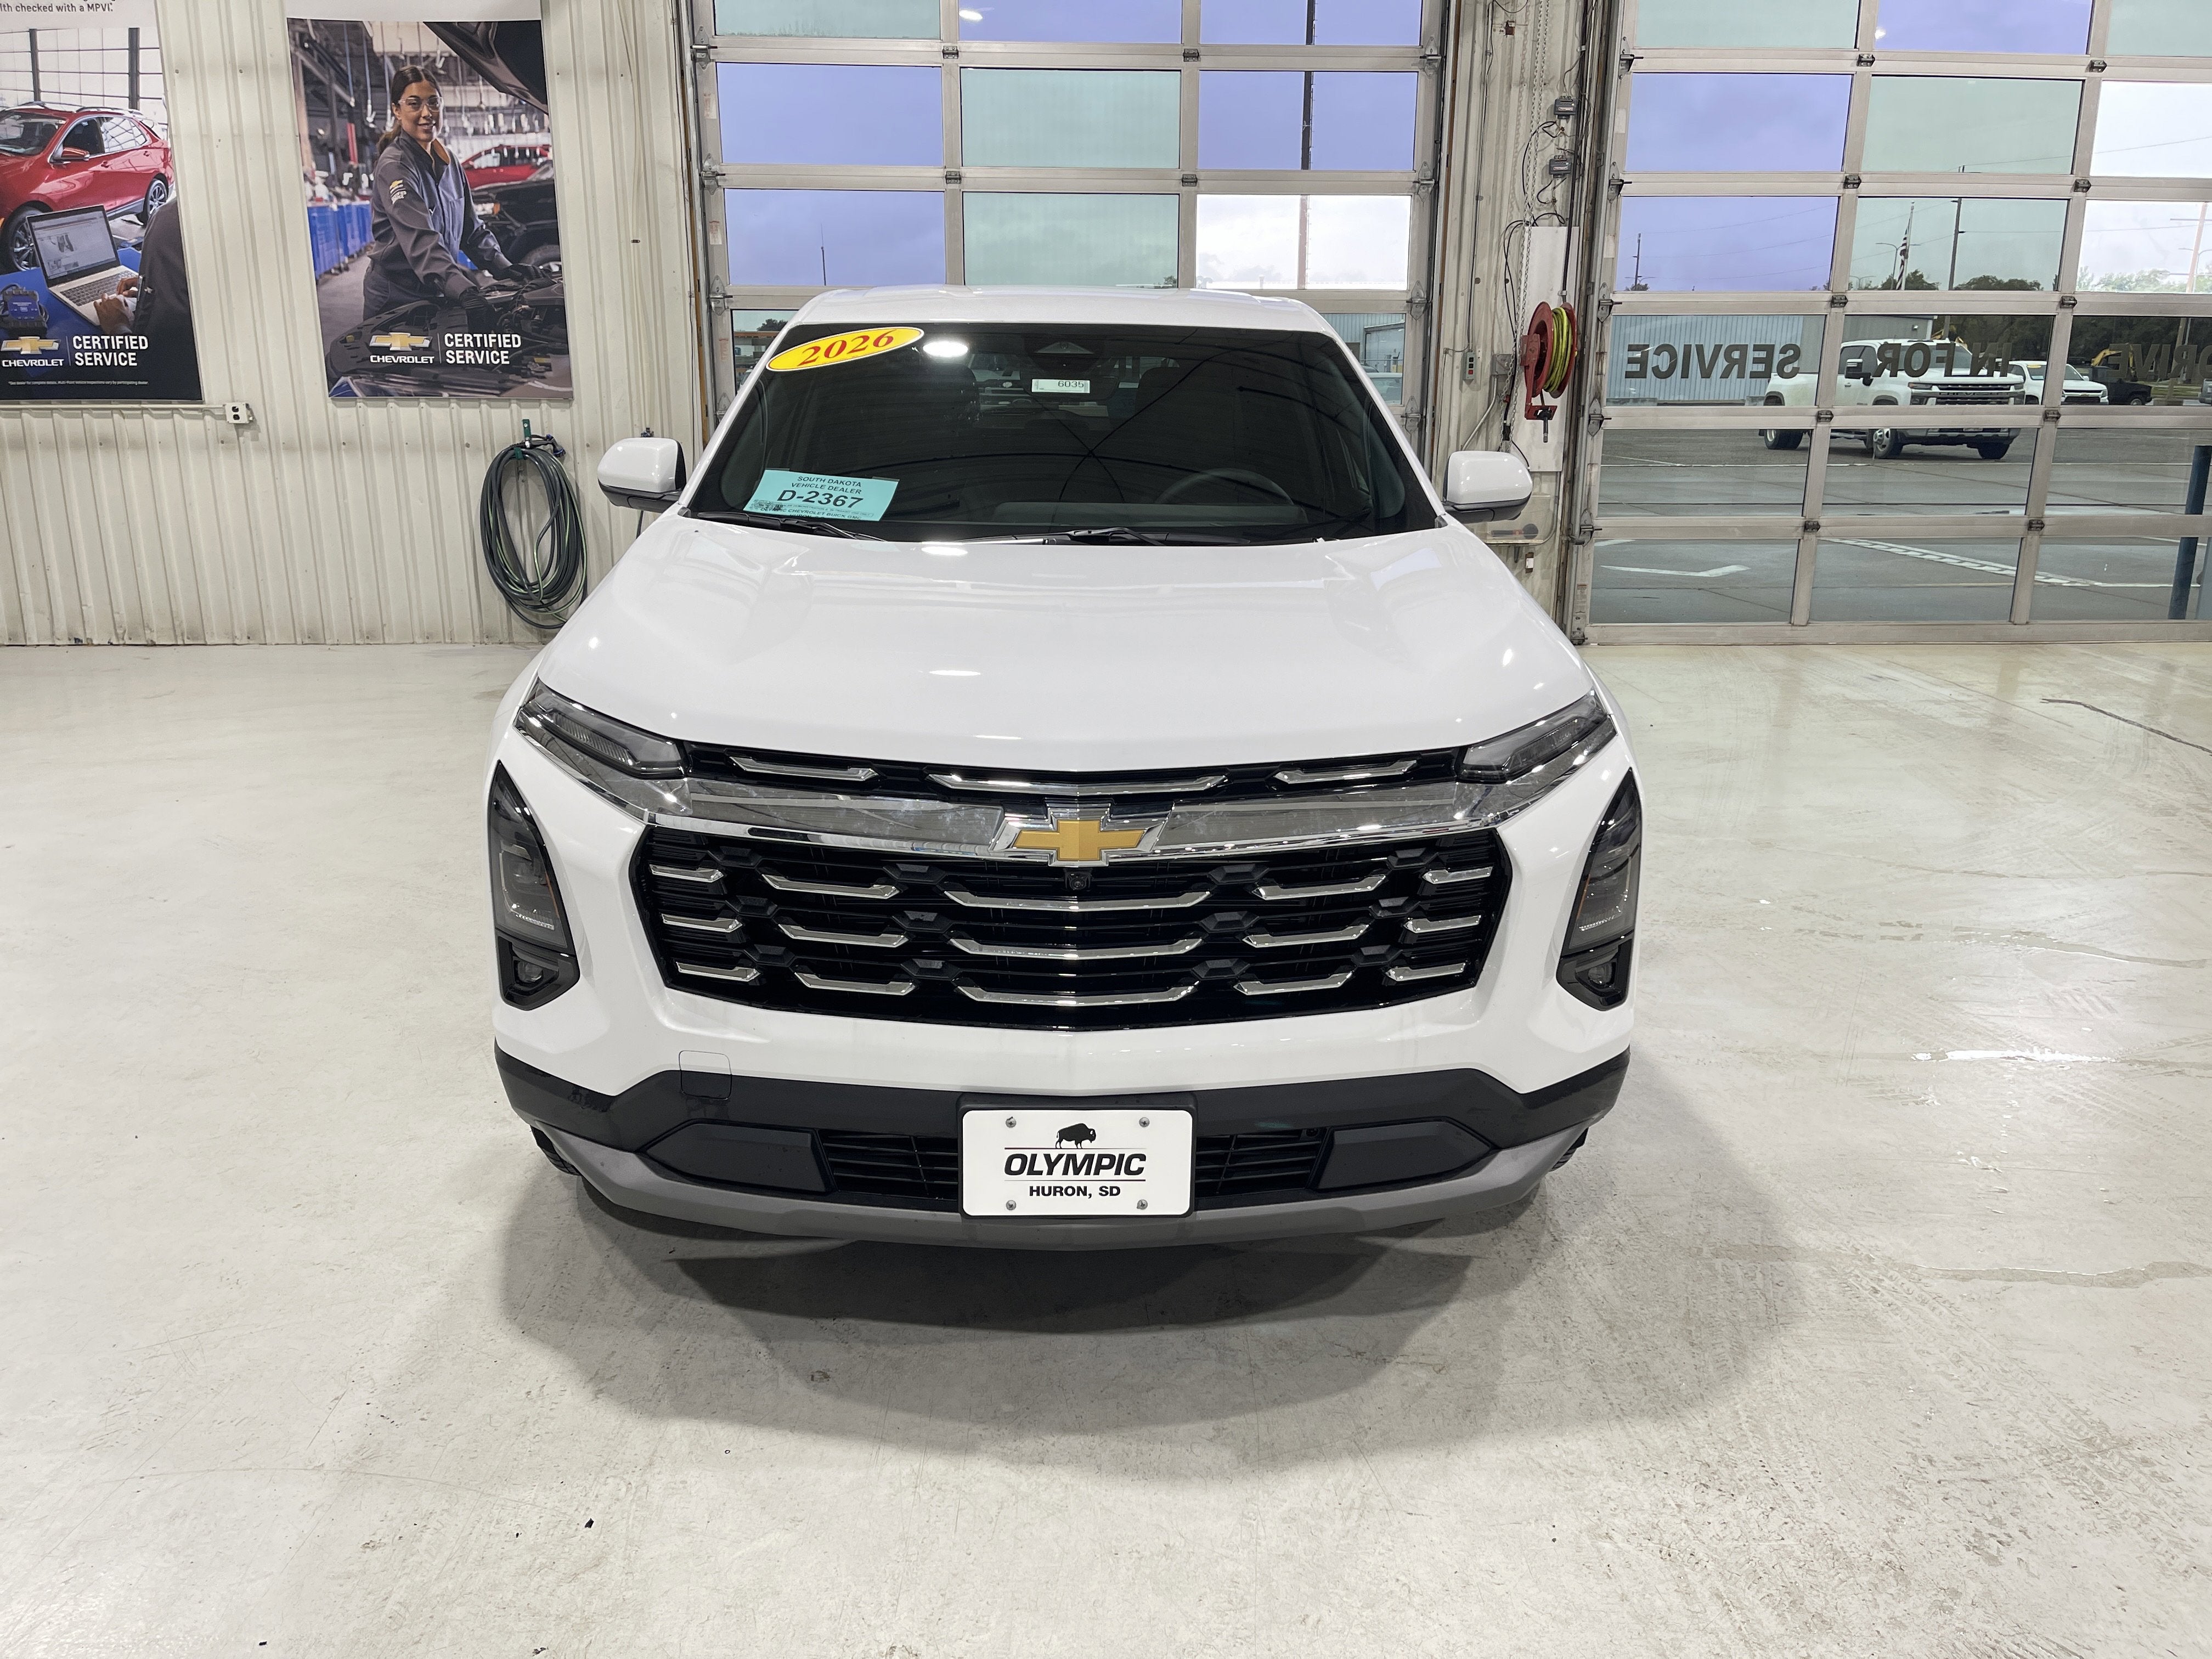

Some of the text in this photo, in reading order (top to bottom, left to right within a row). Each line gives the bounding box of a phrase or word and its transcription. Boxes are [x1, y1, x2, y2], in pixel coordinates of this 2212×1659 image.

[15, 3, 53, 12] checked
[56, 3, 76, 12] with
[72, 335, 149, 350] CERTIFIED
[444, 333, 522, 348] CERTIFIED
[797, 329, 897, 367] 2026
[2, 359, 65, 367] CHEVROLET
[75, 352, 138, 366] SERVICE
[370, 355, 435, 364] CHEVROLET
[445, 350, 510, 365] SERVICE
[827, 478, 861, 487] DAKOTA
[827, 486, 862, 495] DEALER
[777, 490, 864, 508] D-2367
[1004, 1153, 1147, 1176] OLYMPIC
[1029, 1185, 1121, 1199] HURON, SD
